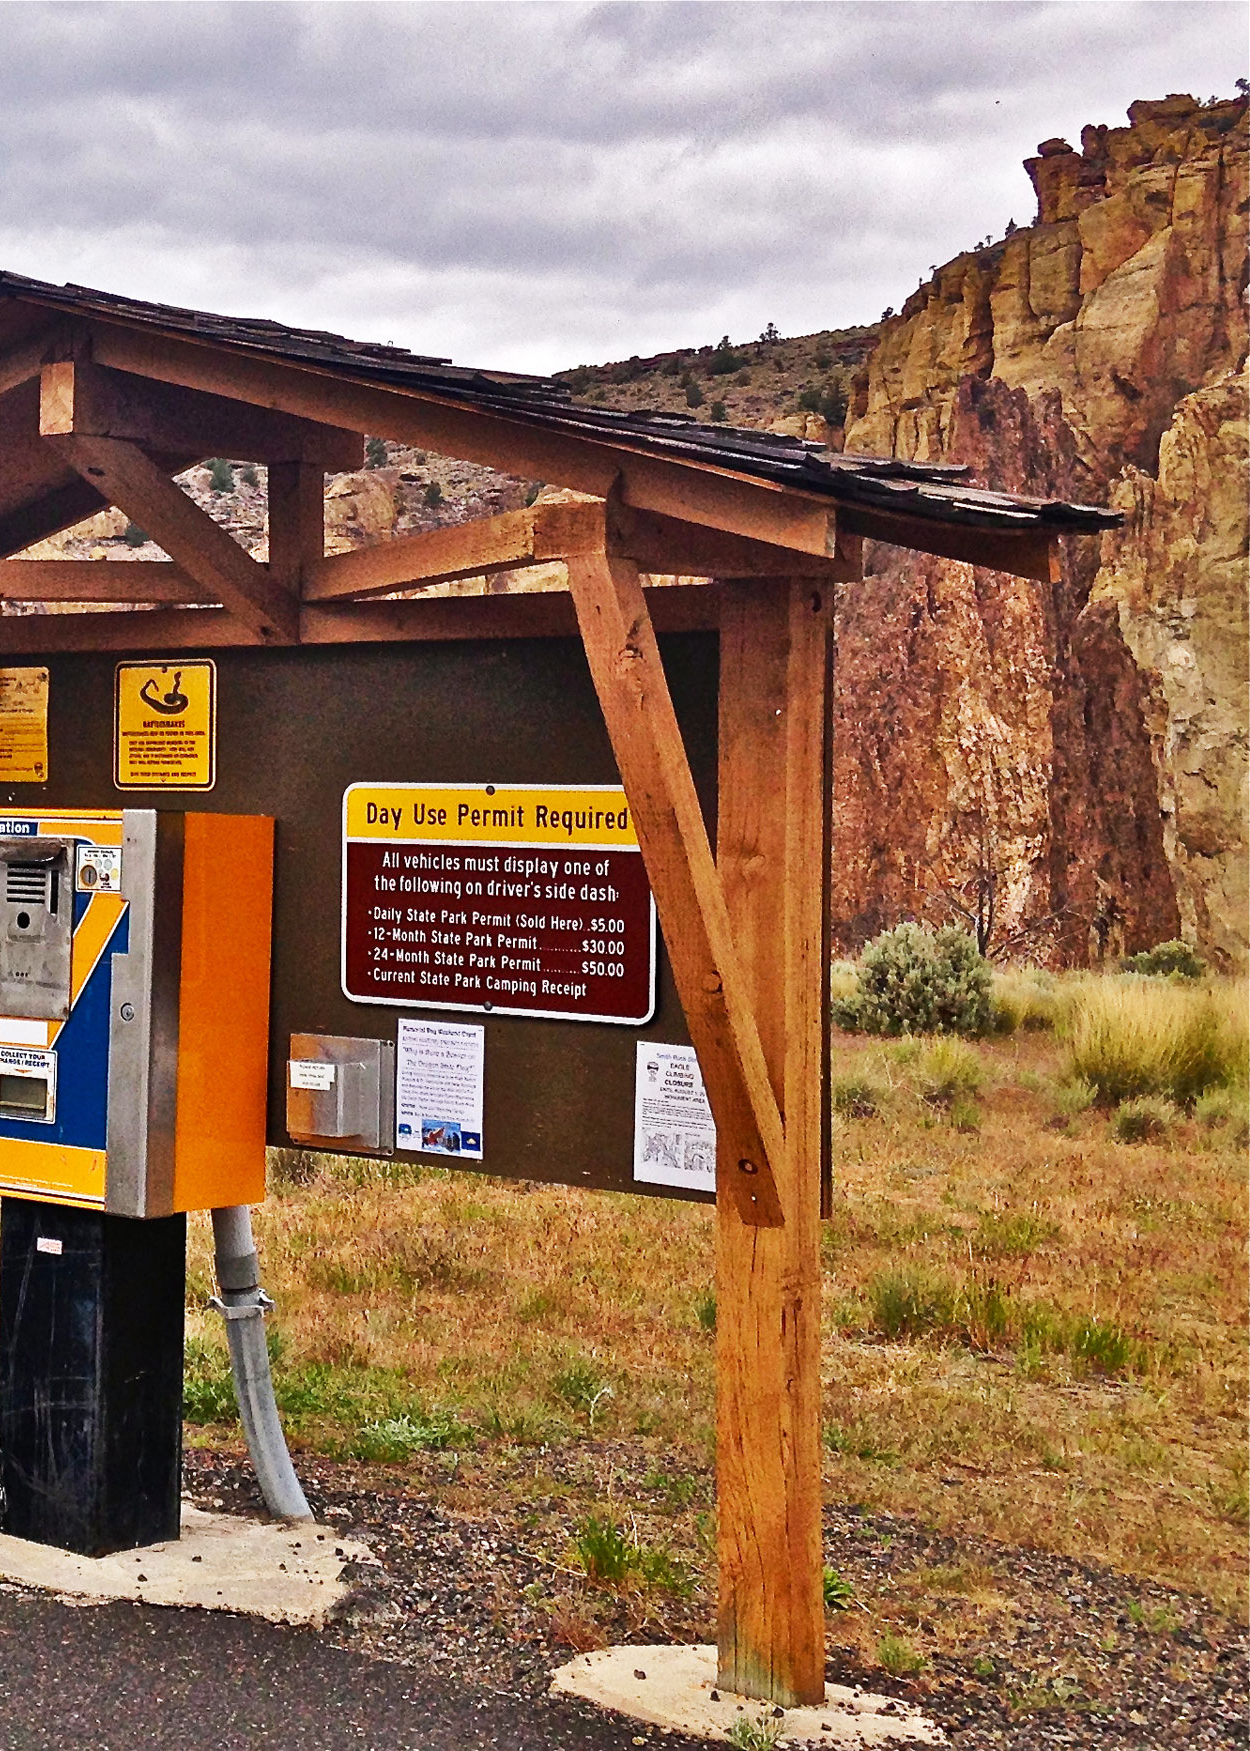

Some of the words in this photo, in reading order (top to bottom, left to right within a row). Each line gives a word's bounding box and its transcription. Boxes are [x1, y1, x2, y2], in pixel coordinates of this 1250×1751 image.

[367, 802, 401, 830] Day
[414, 803, 447, 826] Use
[458, 804, 524, 827] Permit
[536, 805, 628, 835] Required
[382, 851, 400, 868] All
[404, 853, 460, 871] vehicles
[465, 856, 499, 872] must
[504, 856, 558, 878] display
[564, 860, 590, 876] one
[595, 859, 609, 876] of
[375, 874, 396, 892] the
[400, 875, 461, 899] following
[466, 880, 482, 895] on
[487, 879, 541, 898] driver's
[545, 881, 575, 899] side
[374, 906, 402, 924] Daily
[407, 908, 436, 923] State
[441, 909, 467, 924] Park
[472, 911, 511, 927] Permit
[515, 914, 546, 929] (Sold
[590, 918, 625, 933] $5.00
[374, 927, 426, 943] 12-Month
[431, 929, 461, 945] State
[466, 932, 492, 947] Park
[497, 934, 537, 950] Permit
[582, 939, 625, 955] $30.00
[374, 947, 430, 964] 24-Month
[434, 951, 464, 966] State
[469, 953, 496, 968] Park
[501, 955, 541, 972] Permit
[582, 961, 625, 977] $50.00
[374, 967, 415, 983] Current
[420, 970, 450, 986] State
[454, 973, 481, 988] Park
[486, 976, 537, 997] Camping
[542, 980, 586, 1000] Receipt
[1, 1050, 27, 1059] COLLECT
[29, 1053, 45, 1061] YOUR
[25, 1060, 50, 1068] RECEIPT
[664, 1079, 693, 1088] CLOSURE
